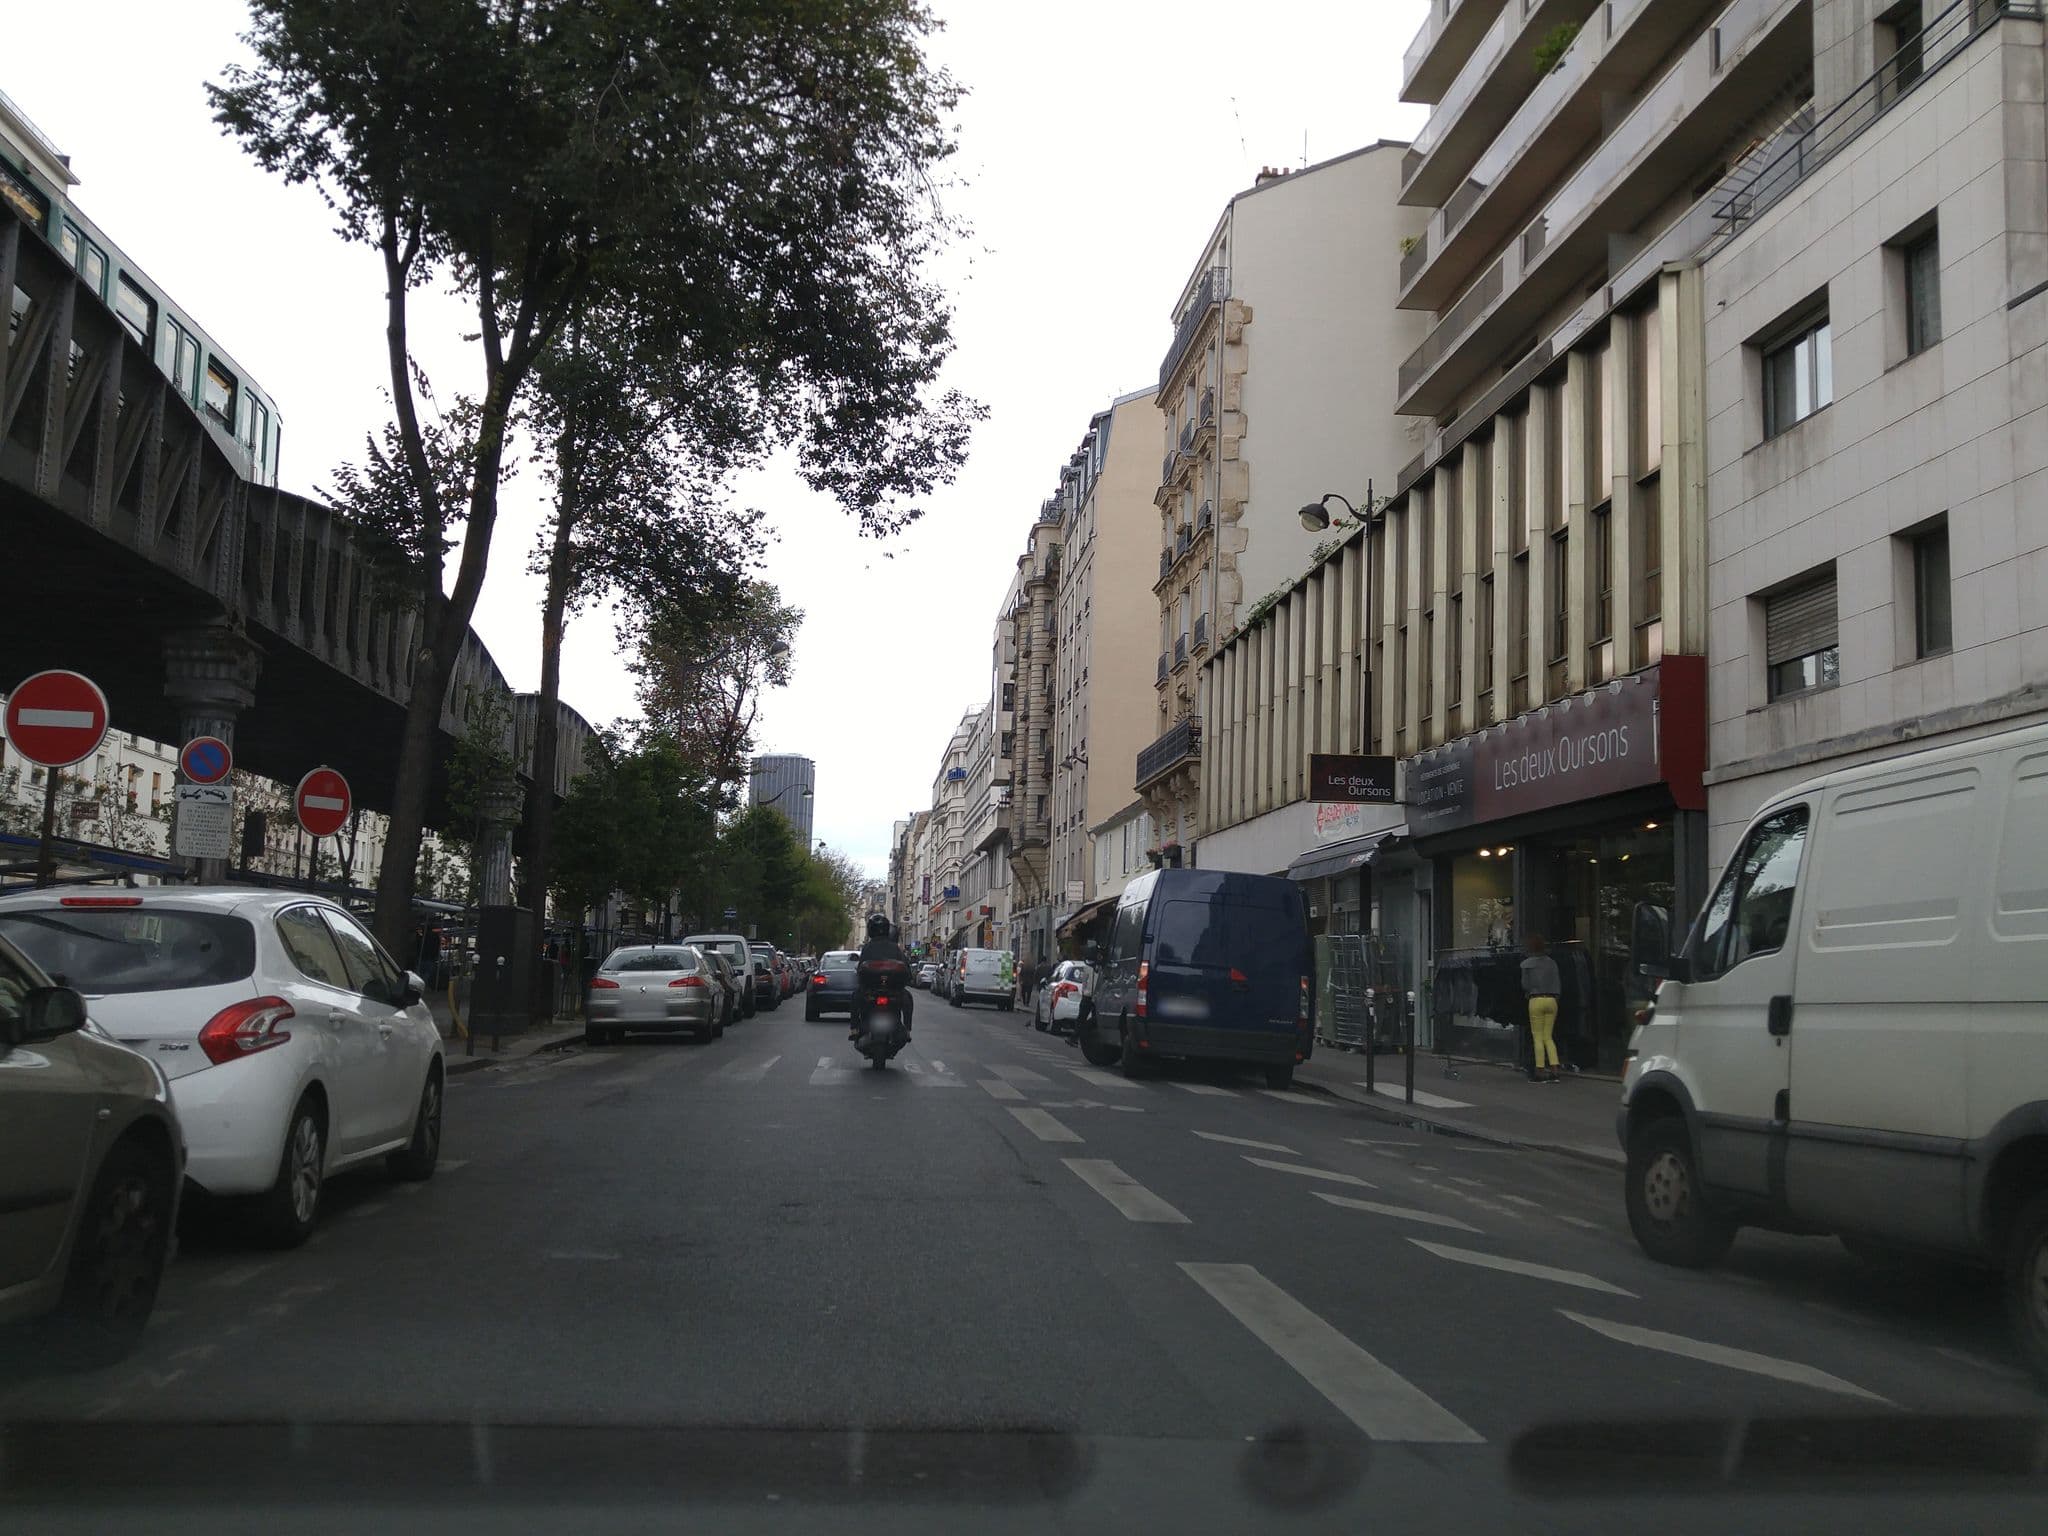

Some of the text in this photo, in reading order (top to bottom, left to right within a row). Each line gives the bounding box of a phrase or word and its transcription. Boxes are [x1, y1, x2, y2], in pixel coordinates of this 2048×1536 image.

[1494, 759, 1518, 791] Les
[1519, 745, 1556, 783] deux
[1558, 725, 1628, 773] Oursons
[1328, 775, 1374, 786] Les deux
[1348, 785, 1391, 796] Oursons
